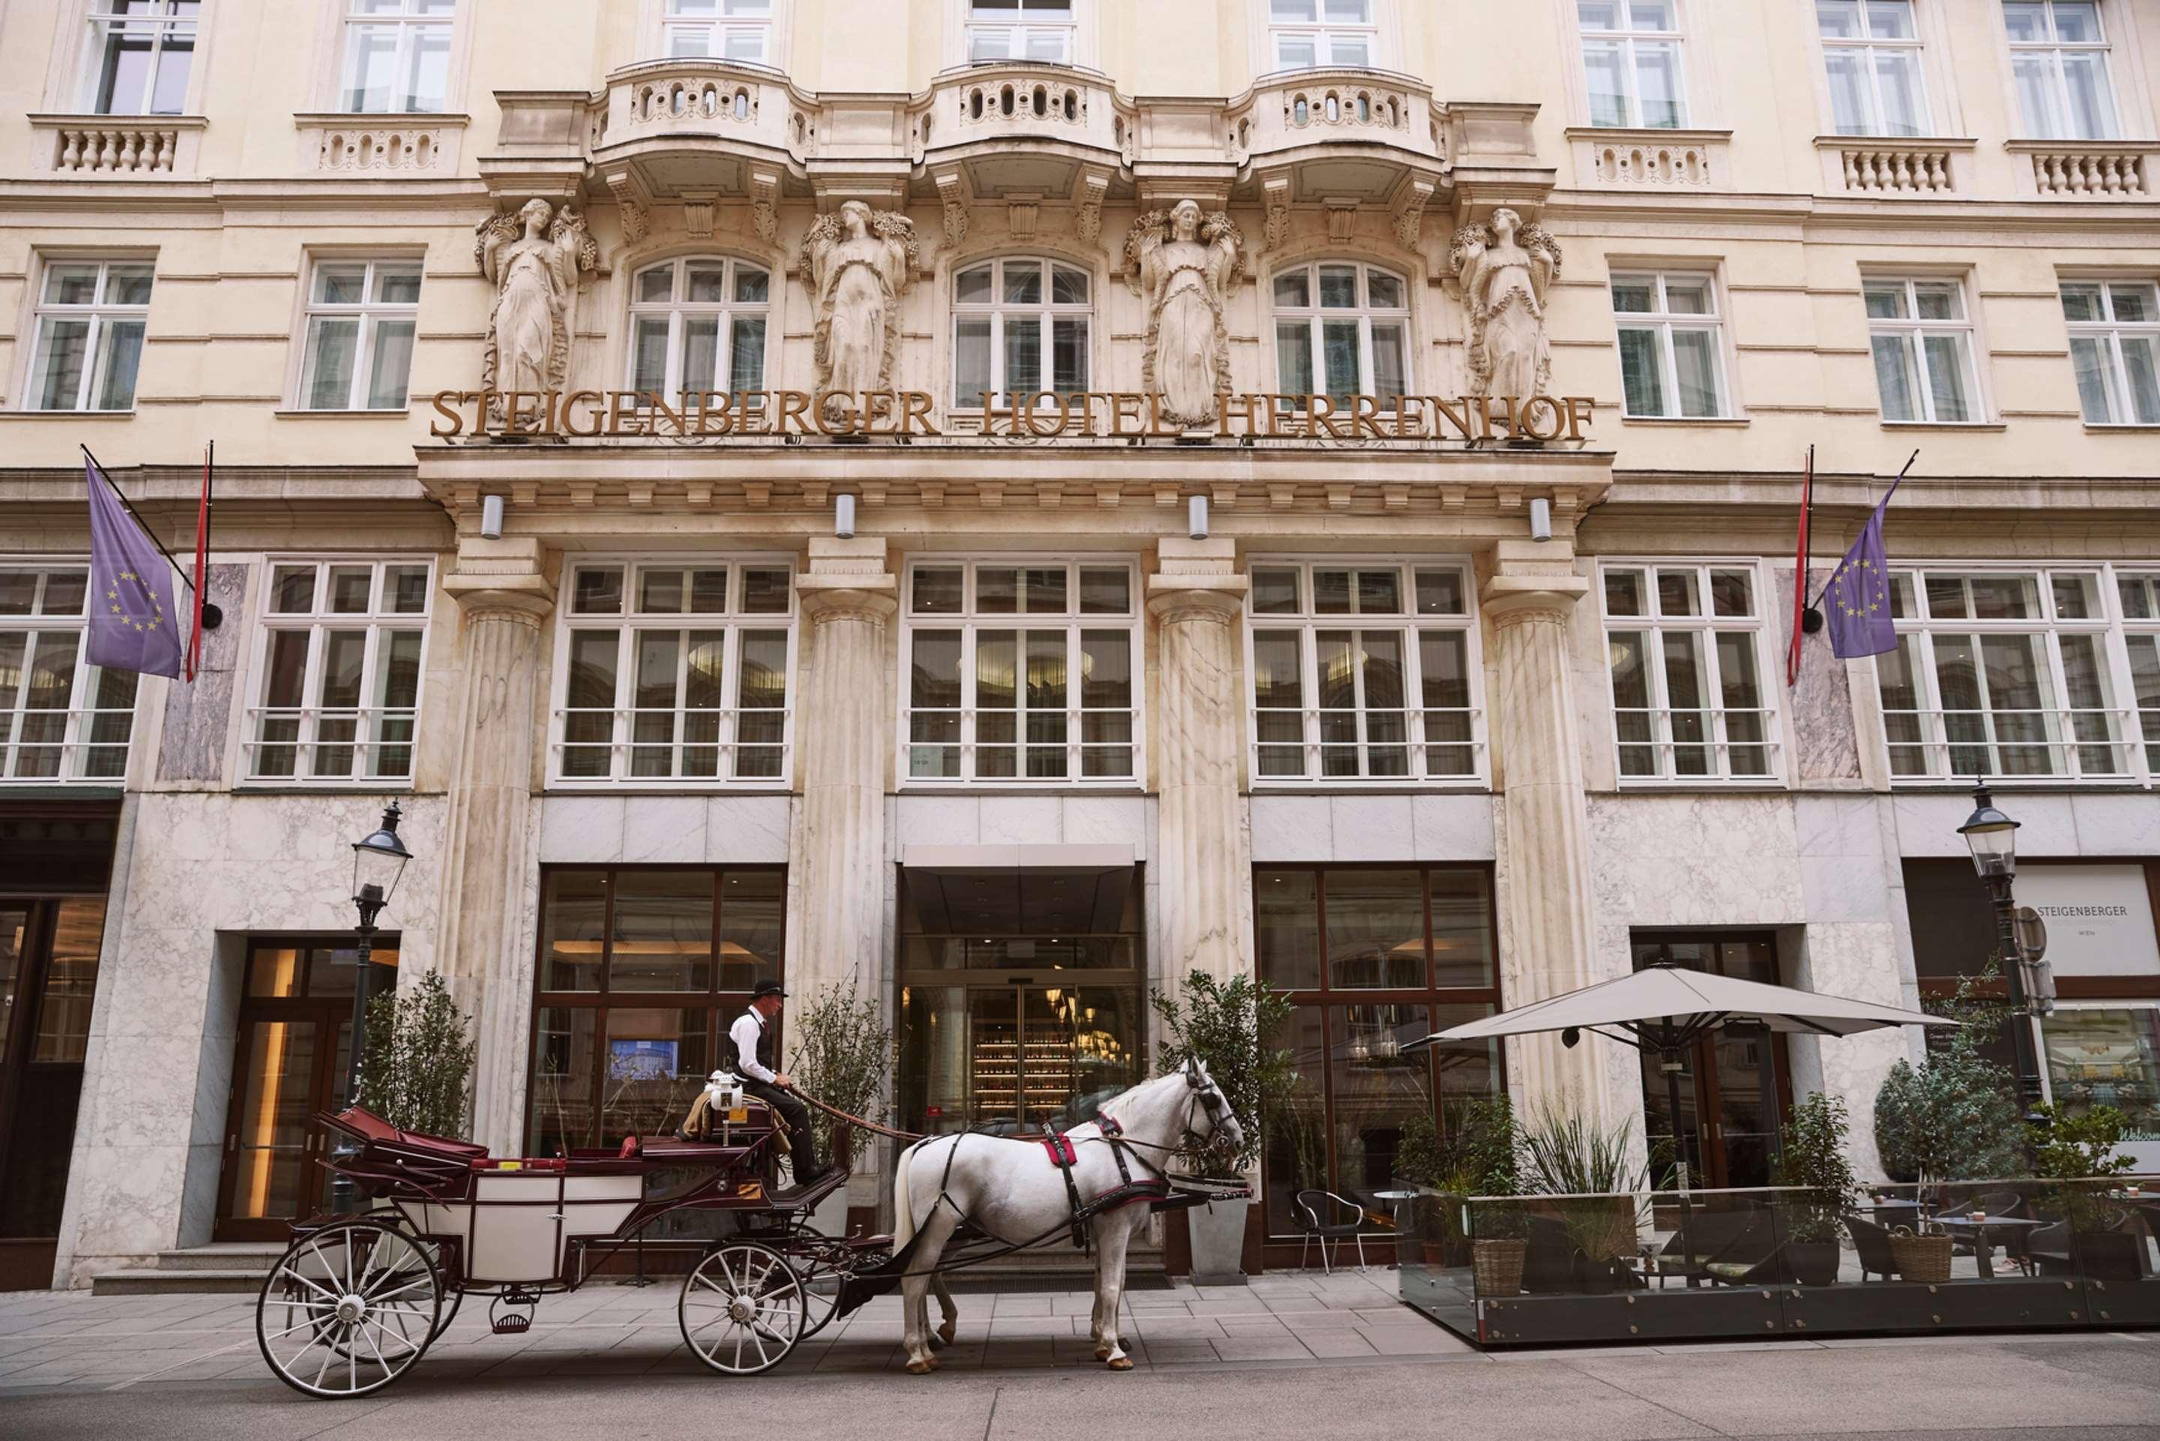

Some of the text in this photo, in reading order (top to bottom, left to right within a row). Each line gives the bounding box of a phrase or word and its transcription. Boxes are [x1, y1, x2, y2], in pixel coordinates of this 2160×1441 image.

[430, 390, 1596, 441] STEIGENBERGER HOTEL HERRENHOF
[2037, 906, 2128, 917] STEIGENBERGER
